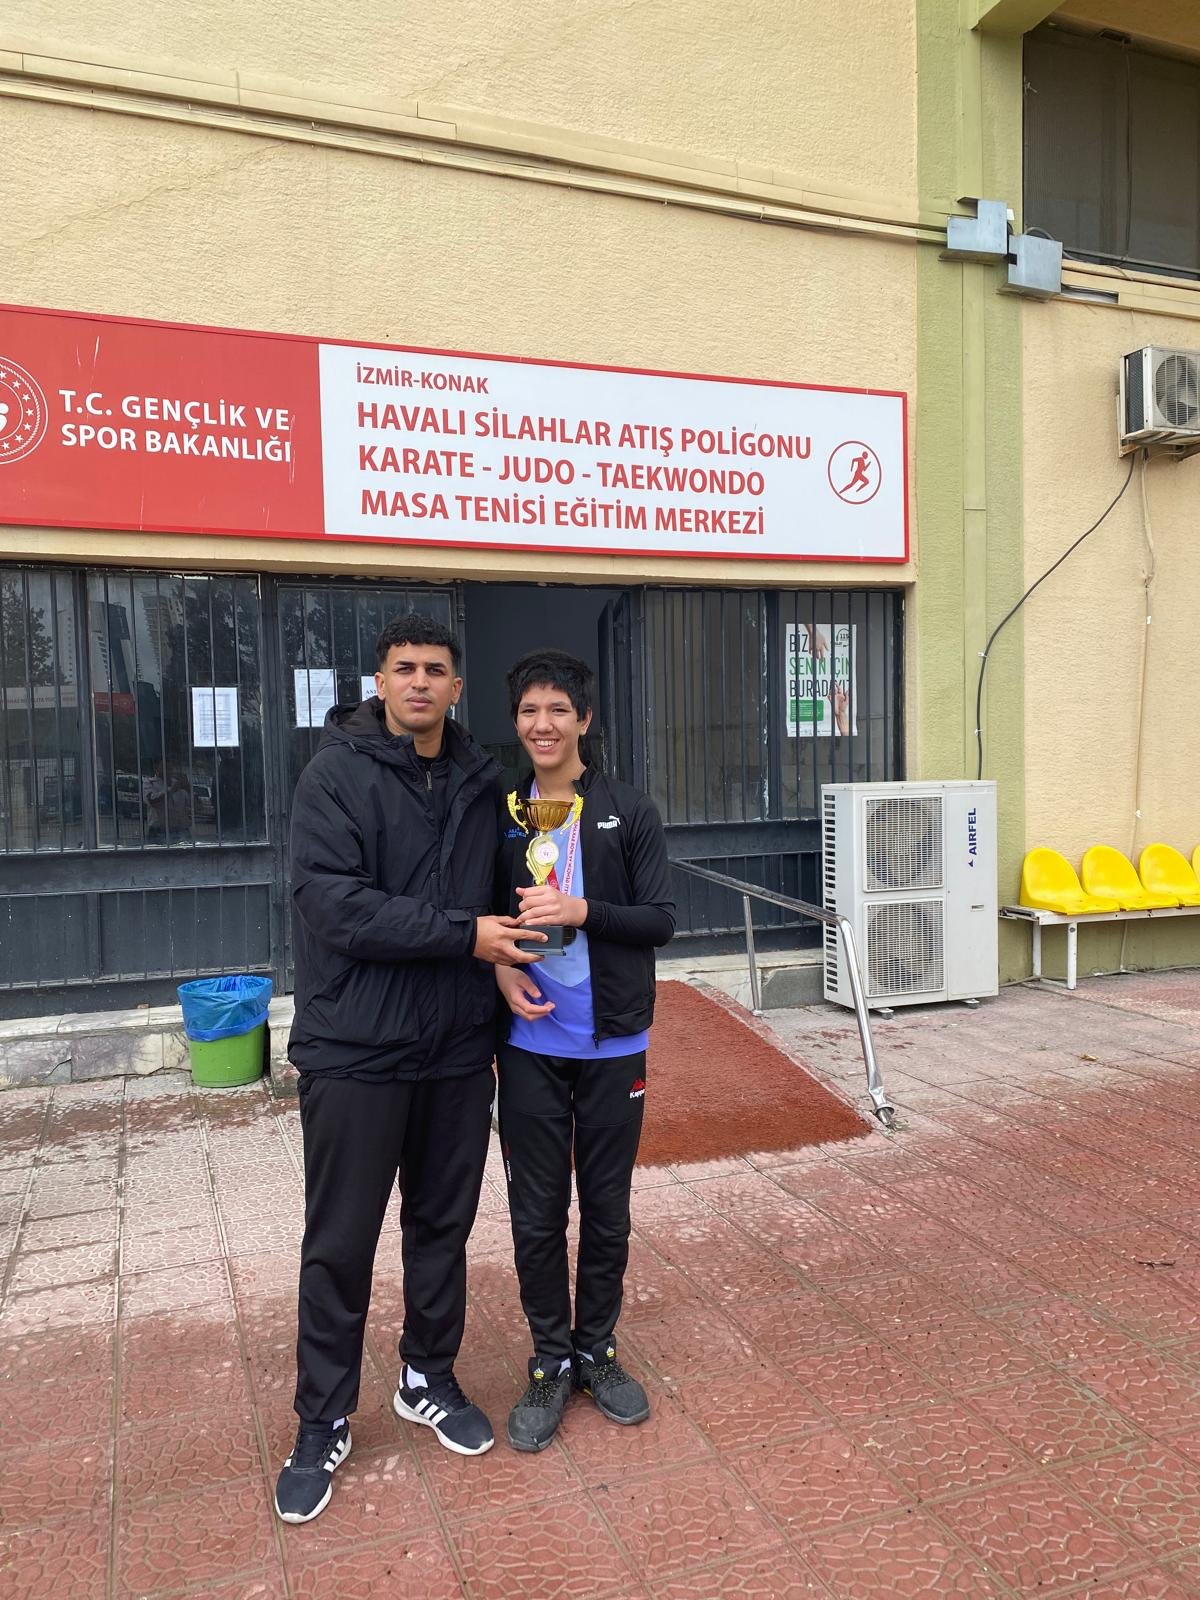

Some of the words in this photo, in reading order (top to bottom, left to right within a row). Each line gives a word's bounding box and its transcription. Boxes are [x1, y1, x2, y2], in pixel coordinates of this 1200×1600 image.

[356, 362, 489, 393] İZMİR-KONAK
[58, 389, 113, 416] T.C.
[121, 395, 247, 430] GENÇLİK
[254, 406, 290, 431] VE
[357, 402, 466, 435] HAVALI
[474, 406, 611, 446] SİLAHLAR
[618, 423, 674, 457] ATIŞ
[680, 425, 811, 459] POLİGONU
[61, 423, 137, 451] SPOR
[145, 430, 292, 463] BAKANLIĞI
[358, 444, 474, 478] KARATE
[498, 455, 575, 485] JUDO
[597, 462, 766, 497] TAEKWONDO
[361, 489, 449, 520] MASA
[454, 494, 546, 526] TENİSİ
[554, 495, 648, 530] EĞİTİM
[654, 506, 765, 535] MERKEZİ
[597, 820, 618, 829] PUMA
[967, 807, 977, 856] AIRFEL
